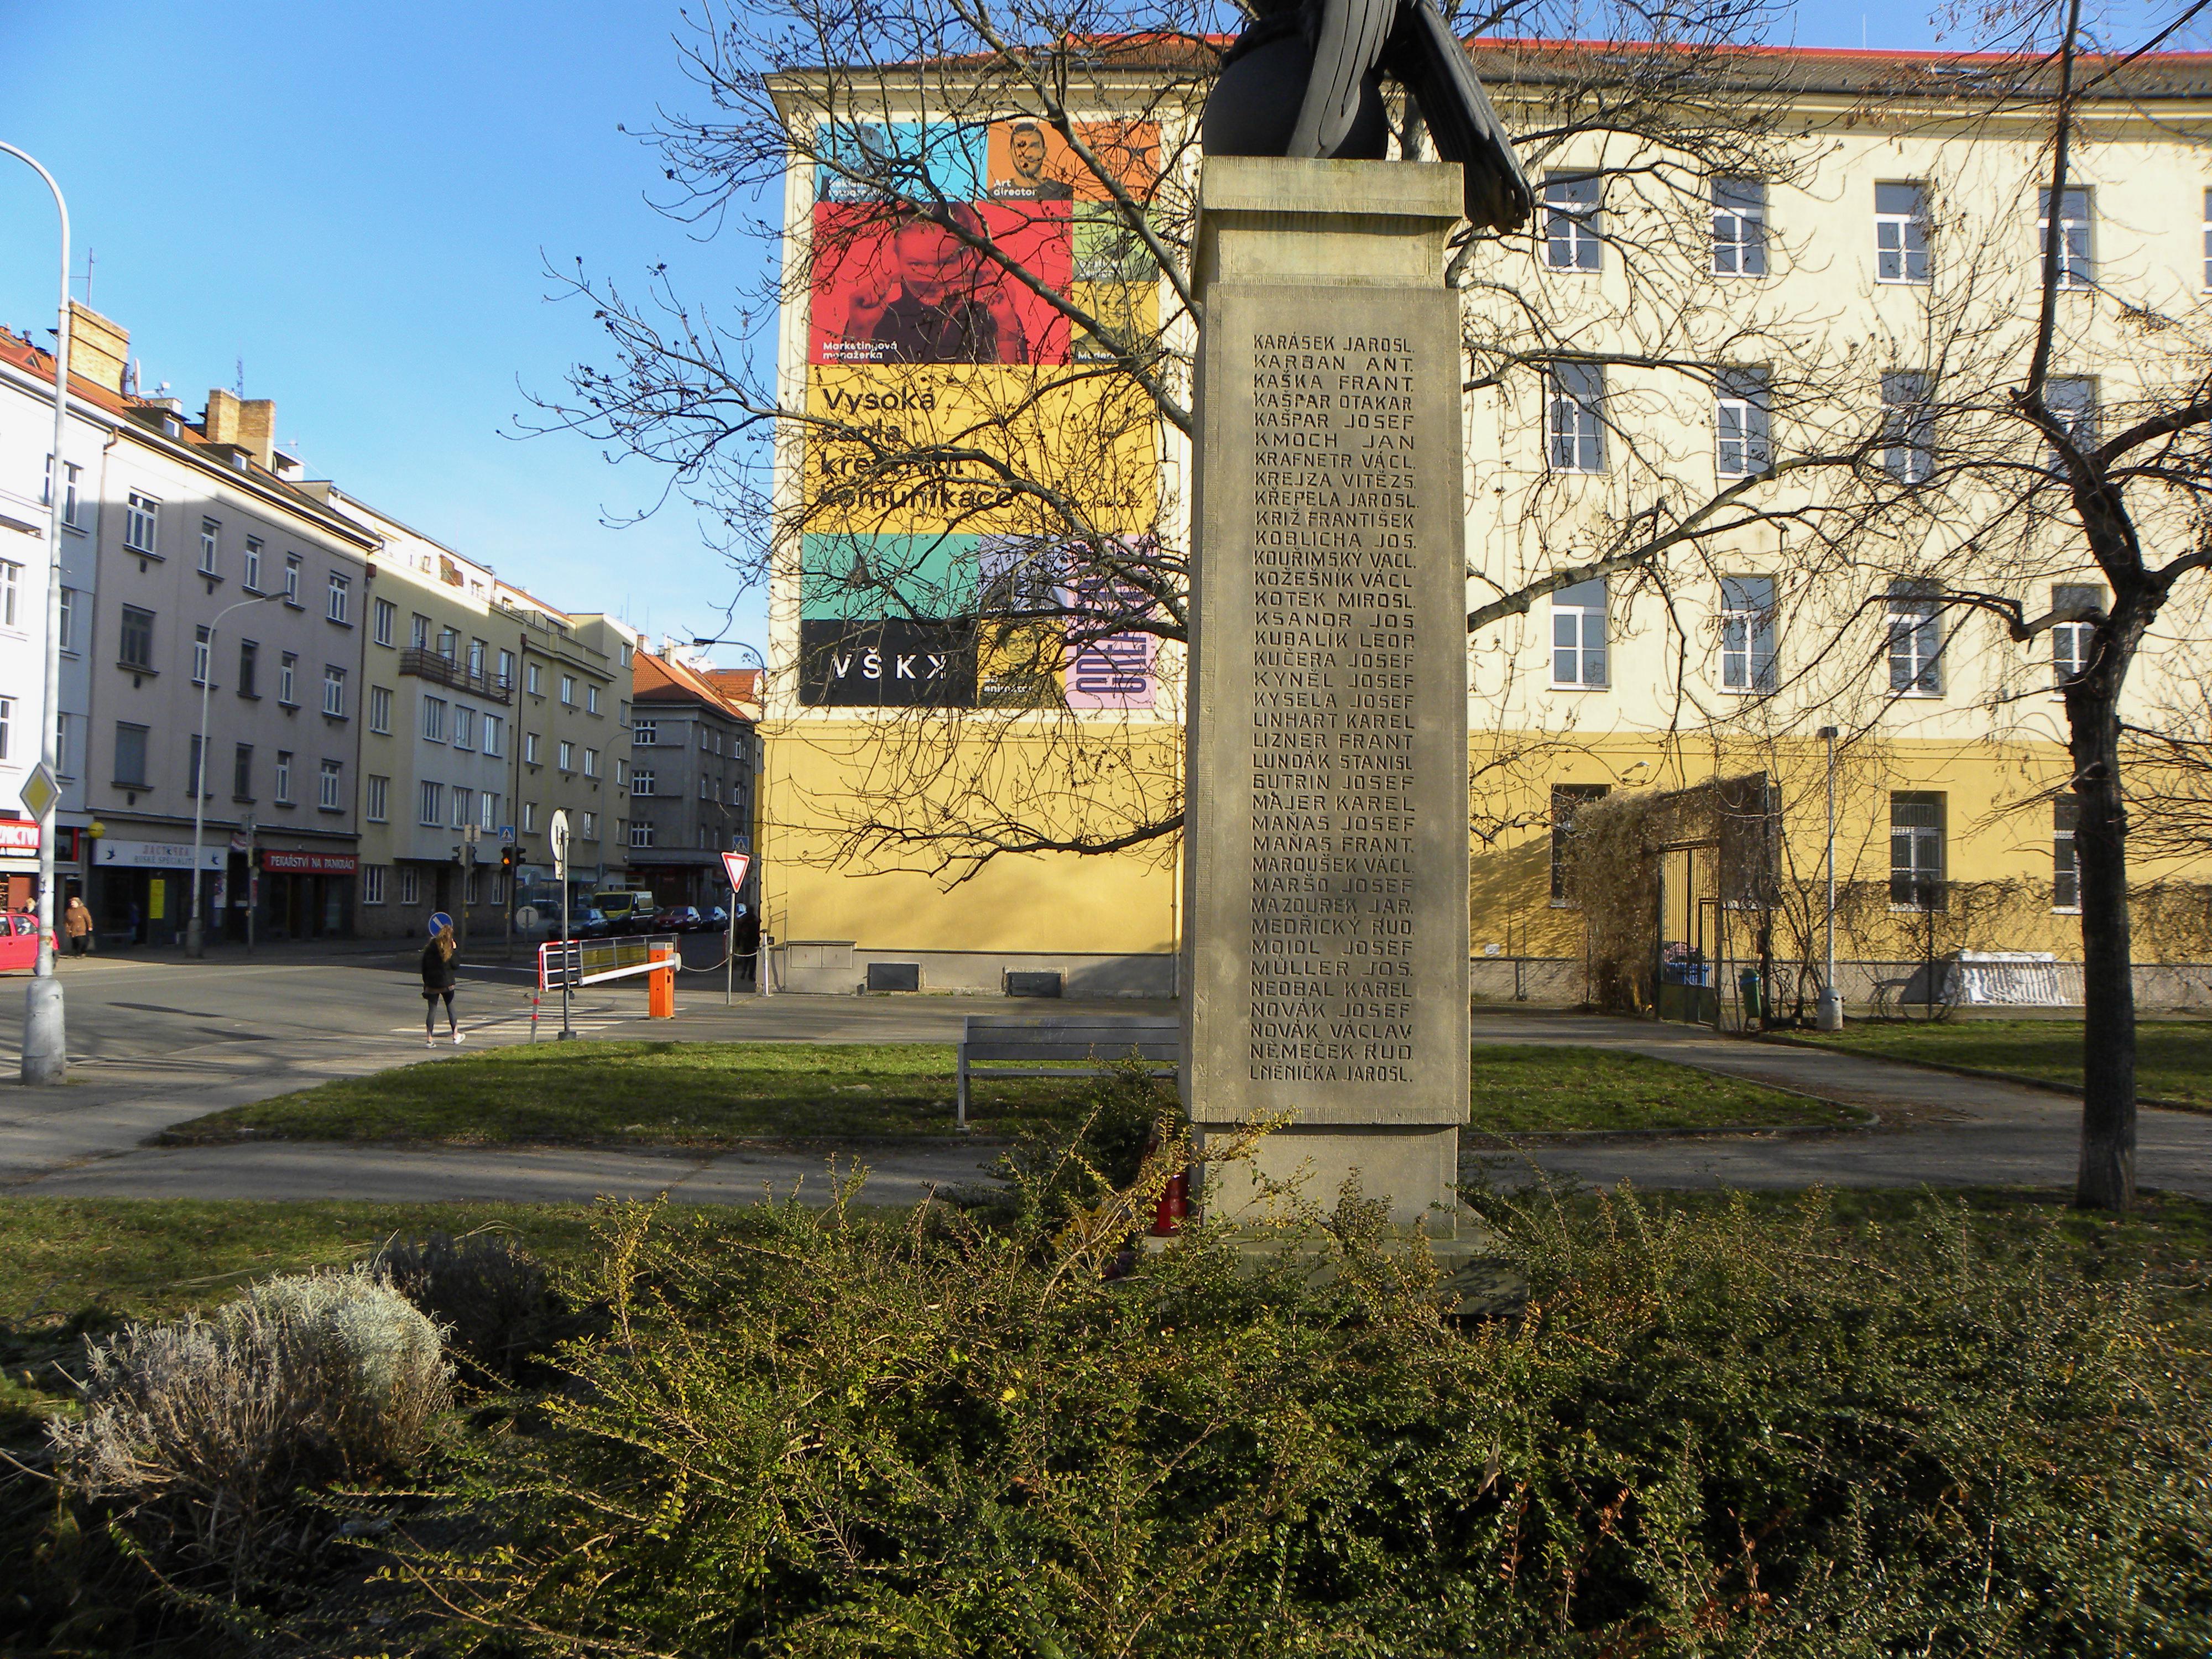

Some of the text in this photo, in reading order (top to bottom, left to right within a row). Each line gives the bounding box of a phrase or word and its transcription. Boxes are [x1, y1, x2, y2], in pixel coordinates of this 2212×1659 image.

[993, 179, 1011, 187] Art
[993, 187, 1036, 196] director
[1254, 332, 1415, 353] KARÁSEK JAROSL.
[1254, 354, 1413, 372] KARBAN ANT.
[1254, 371, 1413, 392] KAŠKA FRANT.
[823, 386, 936, 415] Vysoká
[1254, 390, 1411, 411] KAŠPAR OTAKAR
[1254, 409, 1414, 430] KAŠPAR JOSEF
[1254, 433, 1414, 451] KMOCH JAN
[1254, 451, 1415, 469] KRAFNETR VÁCL.
[1254, 472, 1331, 487] KREJZA
[1254, 487, 1419, 508] KŘEPELA JAROSL.
[1307, 509, 1413, 528] FRANTIŠEK
[1254, 530, 1416, 549] KOBLICHA JOS.
[1253, 546, 1361, 567] KOUŘIMSKÝ
[1254, 567, 1354, 587] KOŽEŠNÍK
[1254, 591, 1416, 609] KOTEK MIROSL.
[1254, 612, 1352, 628] KSANDR
[1254, 628, 1415, 649] KUBALÍK LEOP.
[1253, 648, 1414, 669] KUČERA JOSEF
[1253, 669, 1414, 689] KYNĚL JOSEF
[1253, 692, 1414, 709] KYSELA JOSEF
[1253, 712, 1415, 729] LINHART KAREL
[1253, 733, 1327, 749] LIZNER
[1251, 750, 1330, 769] LUNDÁK
[1340, 775, 1415, 791] JOSEF
[1335, 796, 1415, 812] KAREL
[1251, 812, 1415, 832] MAŇAS JOSEF
[1251, 832, 1414, 853] MAŇAS FRANT.
[159, 857, 195, 866] SPECIALIT
[271, 854, 354, 869] PEKAŘSTVÍ NA PANKRÁCI
[1251, 853, 1415, 874] MAROUŠEK VÁCL.
[1251, 873, 1413, 894] MARŠO JOSEF
[1250, 898, 1413, 915] MAZOUREK JAR.
[1251, 915, 1415, 936] MEDŘICKÝ RUD.
[1251, 940, 1413, 956] MOIDL JOSEF
[1250, 958, 1413, 977] MÜLLER JOS.
[1250, 981, 1412, 998] NEDBAL KAREL
[1250, 998, 1410, 1019] NOVÁK JOSEF
[1250, 1020, 1412, 1040] NOVÁK VÁCLAV
[1249, 1062, 1413, 1082] LNĚNIČKA JAROSL.
